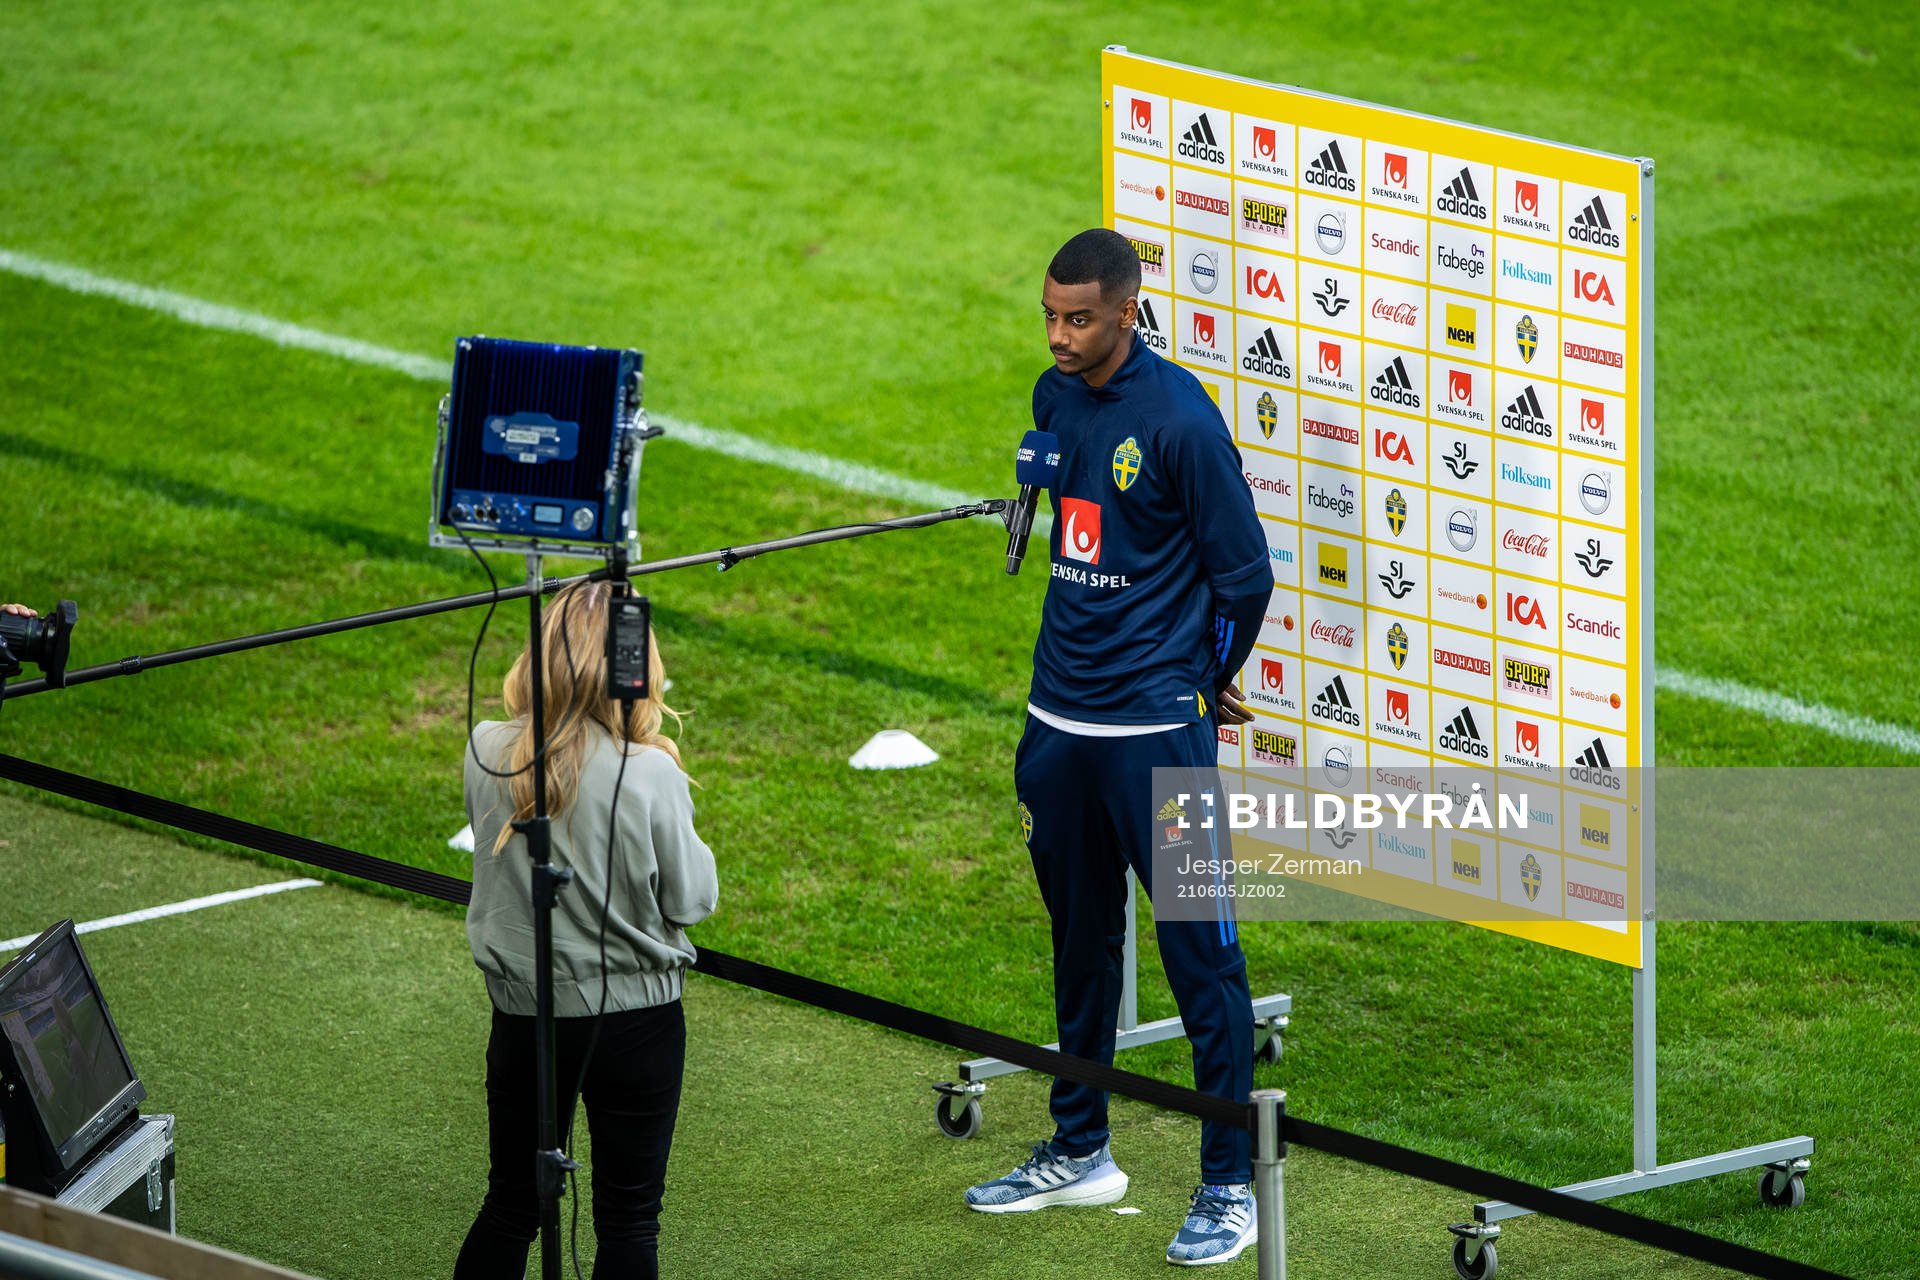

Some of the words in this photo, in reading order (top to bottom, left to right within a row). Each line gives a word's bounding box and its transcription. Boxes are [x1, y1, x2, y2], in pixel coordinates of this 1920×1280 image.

[1120, 131, 1147, 145] SVENSKA
[1148, 138, 1163, 149] SPEL
[1178, 141, 1225, 164] adidas
[1241, 160, 1271, 173] SVENSKA
[1272, 167, 1288, 177] SPEL
[1305, 168, 1356, 192] adidas
[1120, 179, 1154, 196] Swedbank
[1372, 187, 1402, 200] SVENSKA
[1403, 193, 1420, 204] SPEL
[1177, 191, 1228, 214] BAUHAUS
[1243, 198, 1287, 228] SPORT
[1437, 196, 1487, 220] adidas
[1246, 221, 1285, 235] BLADET
[1318, 227, 1341, 237] VOLVO
[1503, 214, 1533, 228] SVENSKA
[1535, 221, 1551, 232] SPEL
[1371, 233, 1420, 256] Scandic
[1568, 224, 1620, 248] adidas
[1193, 266, 1215, 277] VOLVO
[1438, 246, 1484, 278] Fabege
[1502, 259, 1552, 286] Folksam
[1246, 266, 1285, 302] ICA
[1325, 278, 1338, 297] SJ
[1574, 269, 1615, 306] ICA
[1371, 297, 1419, 327] Coca-Cola
[1183, 346, 1211, 360] SVENSKA
[1212, 353, 1227, 363] SPEL
[1566, 343, 1621, 367] BAUHAUS
[1243, 354, 1291, 379] adidas
[1307, 375, 1337, 388] SVENSKA
[1338, 382, 1354, 392] SPEL
[1371, 384, 1420, 408] adidas
[1437, 404, 1467, 417] SVENSKA
[1468, 411, 1485, 422] SPEL
[1304, 420, 1358, 443] BAUHAUS
[1501, 412, 1552, 438] adidas
[1375, 429, 1415, 465] ICA
[1454, 441, 1467, 460] SJ
[1568, 433, 1600, 446] SVENSKA
[1601, 440, 1617, 451] SPEL
[1245, 472, 1291, 496] Scandic
[1501, 463, 1551, 490] Folksam
[1308, 485, 1354, 517] Fabege
[1582, 486, 1607, 497] VOLVO
[1450, 523, 1473, 534] VOLVO
[1502, 528, 1550, 558] Coca-Cola
[1587, 538, 1601, 558] SJ
[1051, 562, 1086, 584] ENSKA
[1090, 572, 1131, 588] SPEL
[1390, 560, 1403, 579] SJ
[1438, 588, 1476, 605] Swedbank
[1507, 592, 1547, 630] ICA
[1310, 619, 1355, 648] Coca-Cola
[1567, 613, 1621, 639] Scandic
[1435, 650, 1489, 675] BAUHAUS
[1505, 658, 1549, 688] SPORT
[1507, 681, 1549, 696] BLADET
[1569, 687, 1608, 704] Swedbank
[1250, 692, 1279, 705] SVENSKA
[1280, 699, 1296, 709] SPEL
[1312, 702, 1360, 727] adidas
[1375, 722, 1405, 736] SVENSKA
[1406, 730, 1422, 741] SPEL
[1253, 729, 1295, 758] SPORT
[1439, 734, 1489, 758] adidas
[1256, 751, 1294, 766] BLADET
[1326, 760, 1349, 770] VOLVO
[1504, 754, 1535, 768] SVENSKA
[1536, 761, 1551, 772] SPEL
[1376, 768, 1423, 792] Scandic
[1569, 764, 1620, 790] adidas
[1157, 809, 1187, 820] adidas
[1377, 832, 1426, 859] Folksam
[1569, 883, 1624, 909] BAUHAUS
